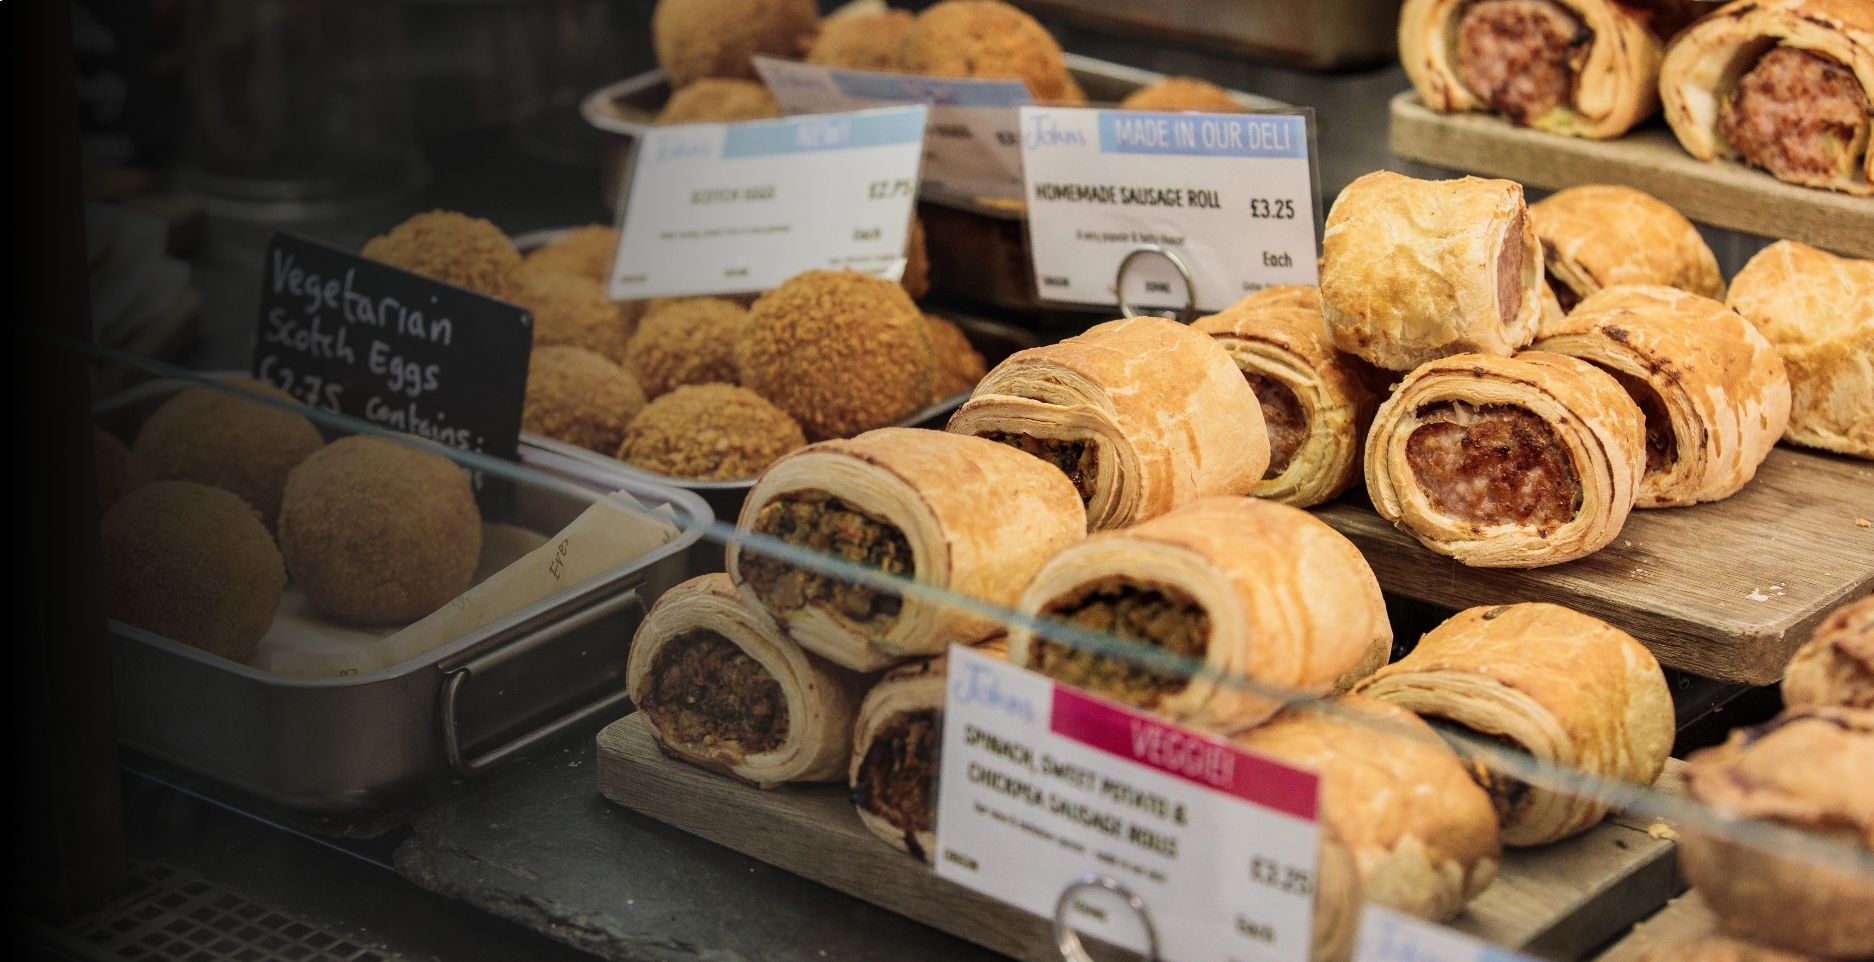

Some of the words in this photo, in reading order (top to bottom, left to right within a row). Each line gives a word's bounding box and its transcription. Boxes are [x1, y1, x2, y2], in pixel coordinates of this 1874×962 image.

[1025, 114, 1088, 150] Johns
[1115, 119, 1169, 147] MADE
[1175, 120, 1196, 148] IN
[1201, 121, 1243, 149] OUR
[1249, 122, 1291, 150] DELI
[1034, 182, 1116, 204] HOMEMADE
[1120, 186, 1184, 208] SAUSAGE
[1187, 189, 1222, 210] ROLL
[1251, 198, 1295, 219] £3.25
[1262, 250, 1293, 268] Each
[272, 248, 453, 346] Vegetarian
[264, 308, 355, 364] Scotch
[368, 339, 441, 397] Eggs
[1130, 717, 1236, 790] VEGGIE!
